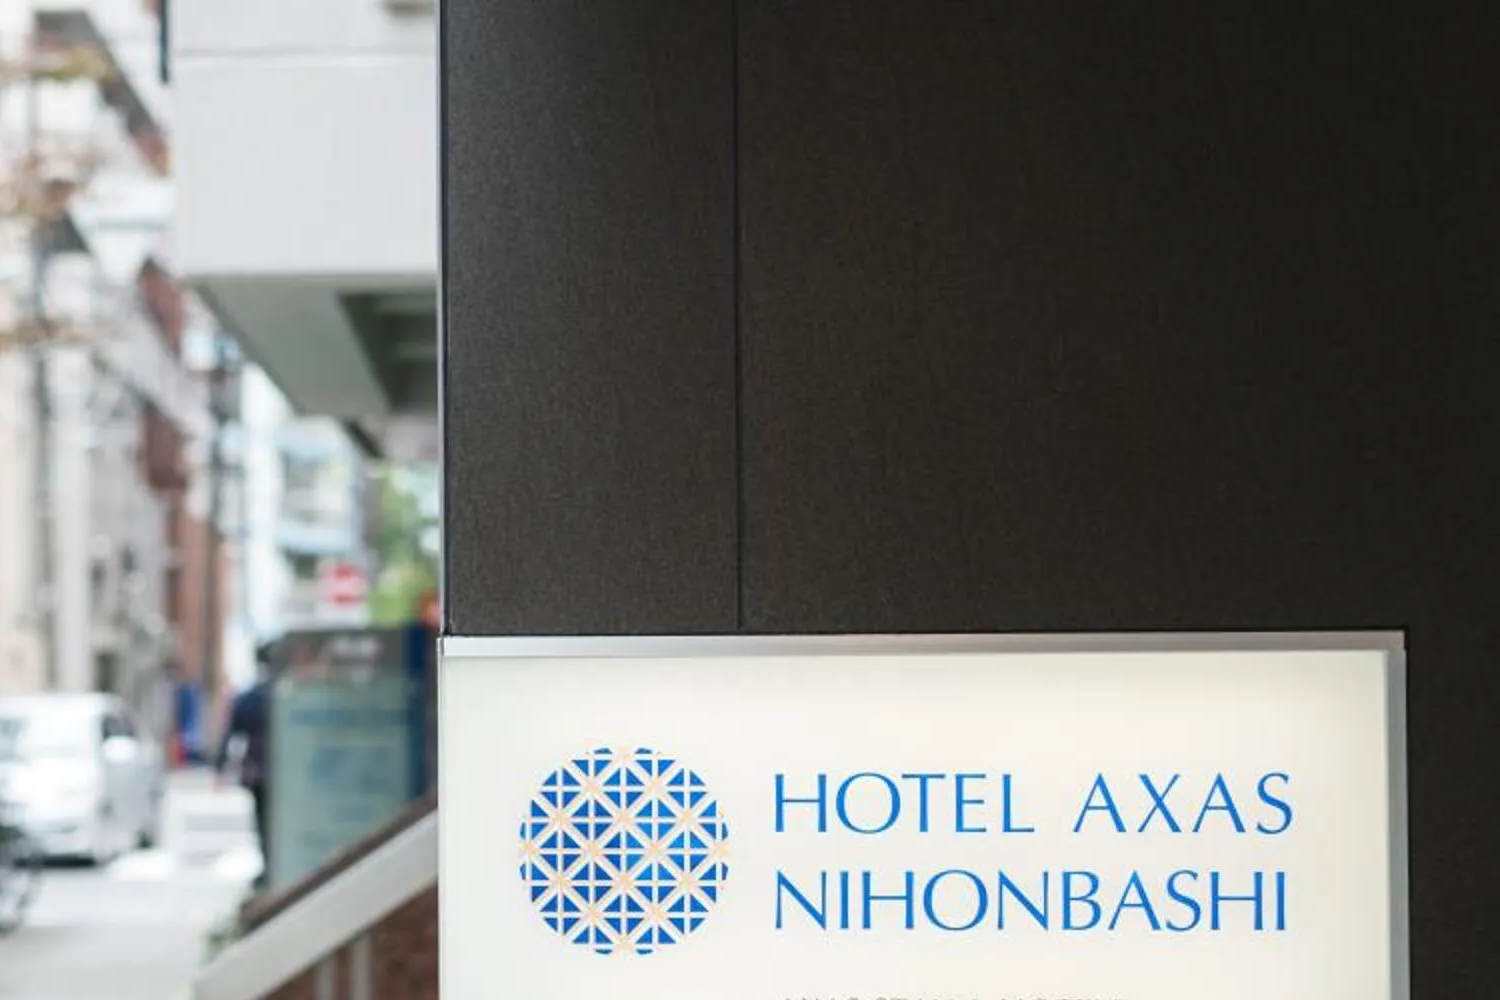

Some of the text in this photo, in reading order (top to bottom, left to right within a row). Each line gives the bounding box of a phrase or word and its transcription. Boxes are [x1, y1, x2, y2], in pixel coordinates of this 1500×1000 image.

[775, 772, 1293, 834] HOTEL AXAS
[775, 870, 1287, 932] NIHONBASHI
